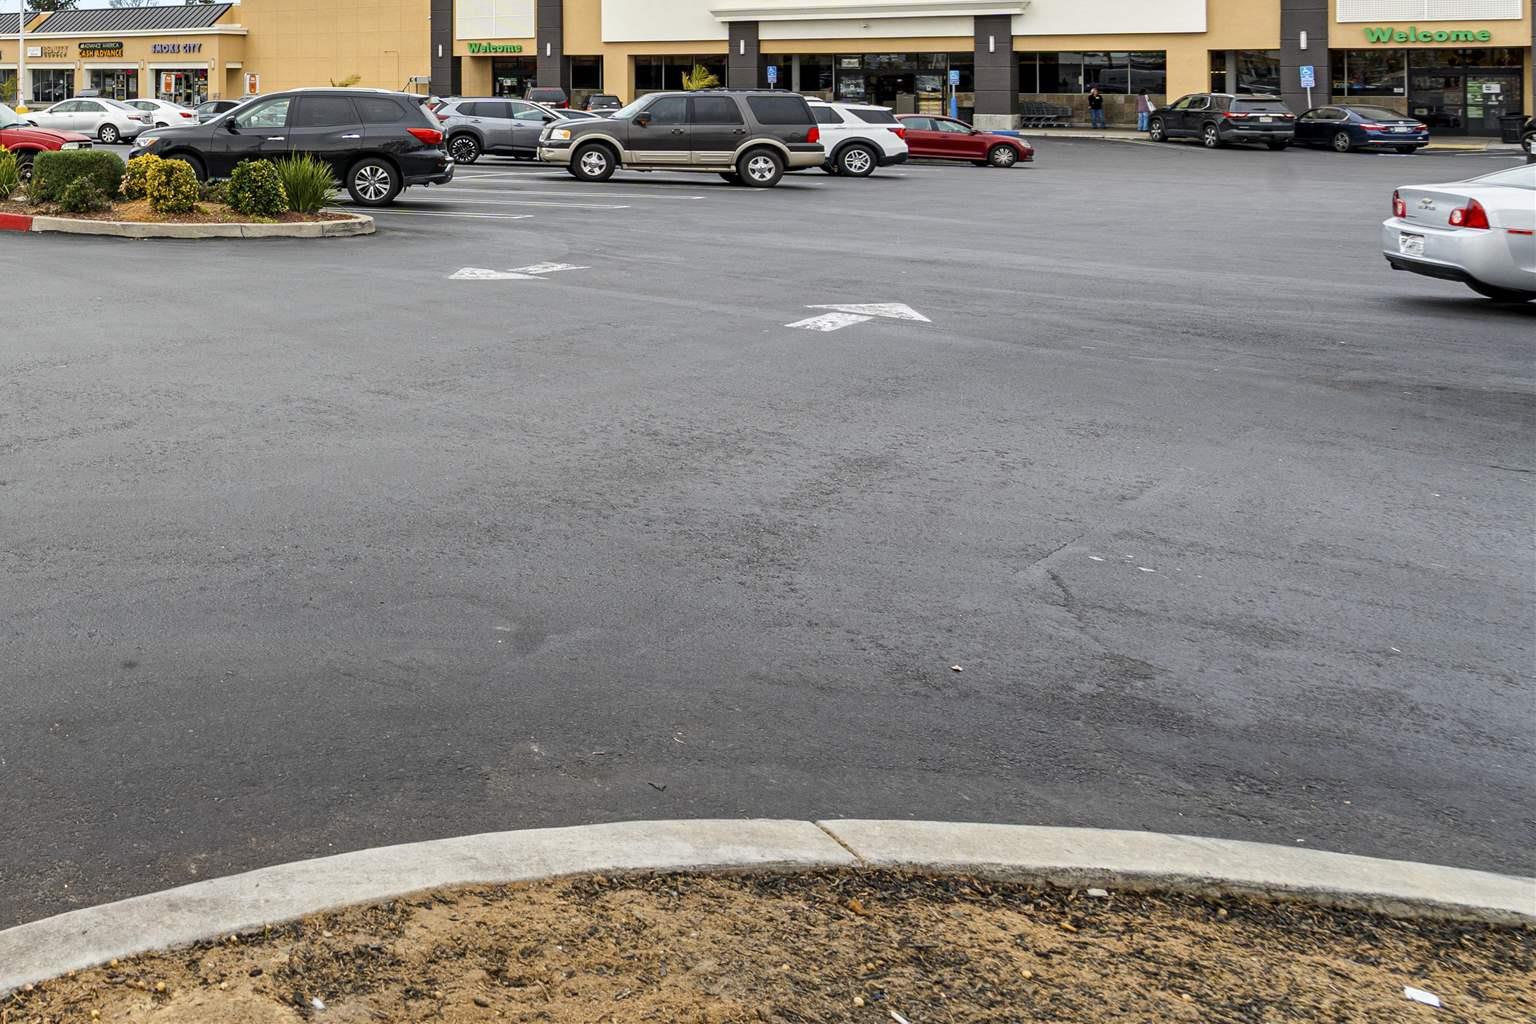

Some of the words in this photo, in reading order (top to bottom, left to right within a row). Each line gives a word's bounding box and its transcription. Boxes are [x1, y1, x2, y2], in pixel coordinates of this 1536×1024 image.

[1362, 25, 1493, 44] Welcome
[79, 49, 95, 57] CASH
[95, 48, 123, 57] ADVANCE
[152, 43, 181, 54] SMOKE
[183, 43, 203, 54] CITY
[466, 42, 523, 54] Welcome
